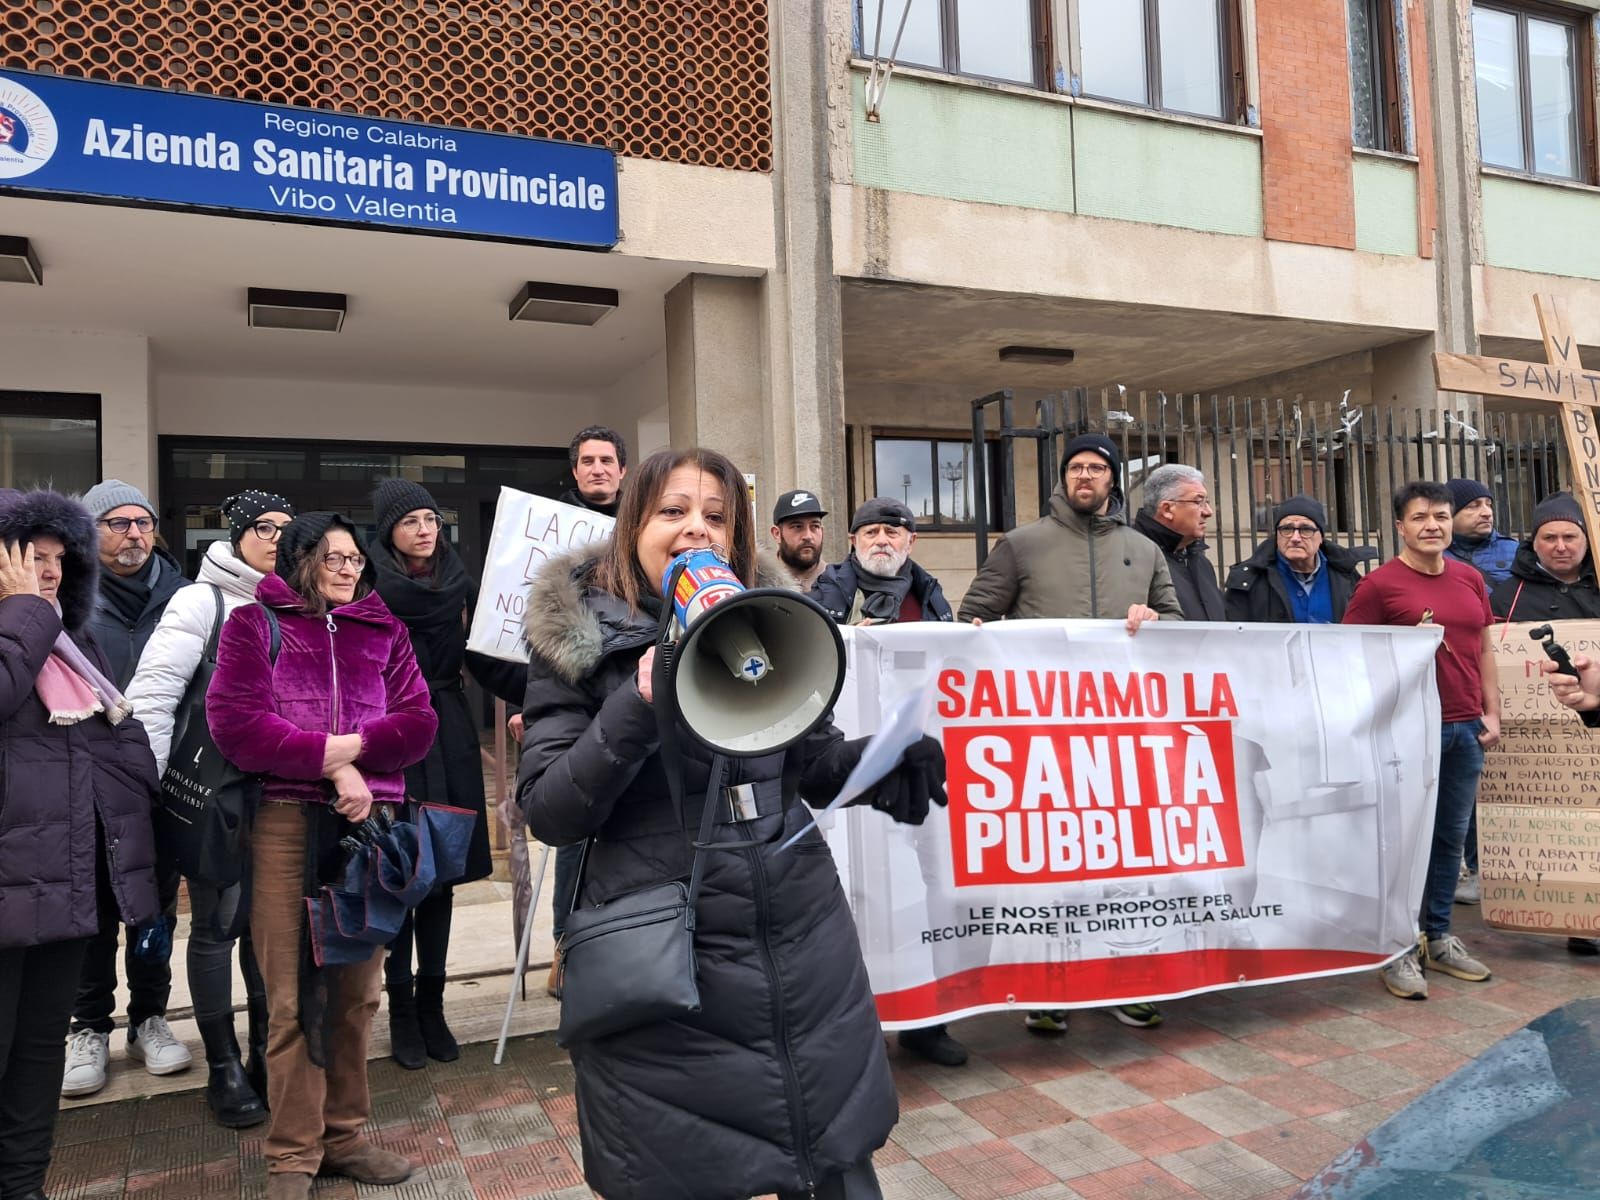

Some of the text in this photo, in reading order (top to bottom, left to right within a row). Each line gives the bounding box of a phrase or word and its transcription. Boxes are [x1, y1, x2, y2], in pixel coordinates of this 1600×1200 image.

[264, 112, 457, 152] Regione Calabria
[82, 118, 606, 212] Azienda Sanitaria Provinciale
[268, 185, 458, 224] Vibo Valentia
[524, 507, 559, 545] LA
[937, 668, 1239, 718] SALVIAMO LA
[1500, 726, 1594, 741] SERRA SAN
[1485, 743, 1506, 753] ON
[1514, 743, 1557, 754] SIAMO
[966, 724, 1225, 810] SANITÀ
[1485, 755, 1530, 767] OSTRO
[1535, 756, 1584, 768] GIUSTO
[1480, 770, 1507, 780] NON
[1518, 770, 1562, 781] SIAMO
[1481, 782, 1598, 794] DA MACELLO DA
[1481, 794, 1584, 806] STABILIMENTO
[1528, 819, 1576, 832] NOSTRO
[965, 805, 1229, 874] PUBBLICA
[1481, 831, 1540, 845] SERVIZI
[1482, 845, 1511, 857] NON
[1518, 848, 1531, 858] CI
[1482, 858, 1516, 870] STRA
[1525, 860, 1578, 873] POLITICA
[1483, 886, 1527, 902] LOTTA
[1533, 889, 1577, 904] CIVILE
[969, 893, 1233, 920] LE NOSTRE PROPOSTE PER
[921, 903, 1285, 944] RECUPERARE IL DIRITTO ALLA SALUTE
[1489, 908, 1554, 927] COMITATO
